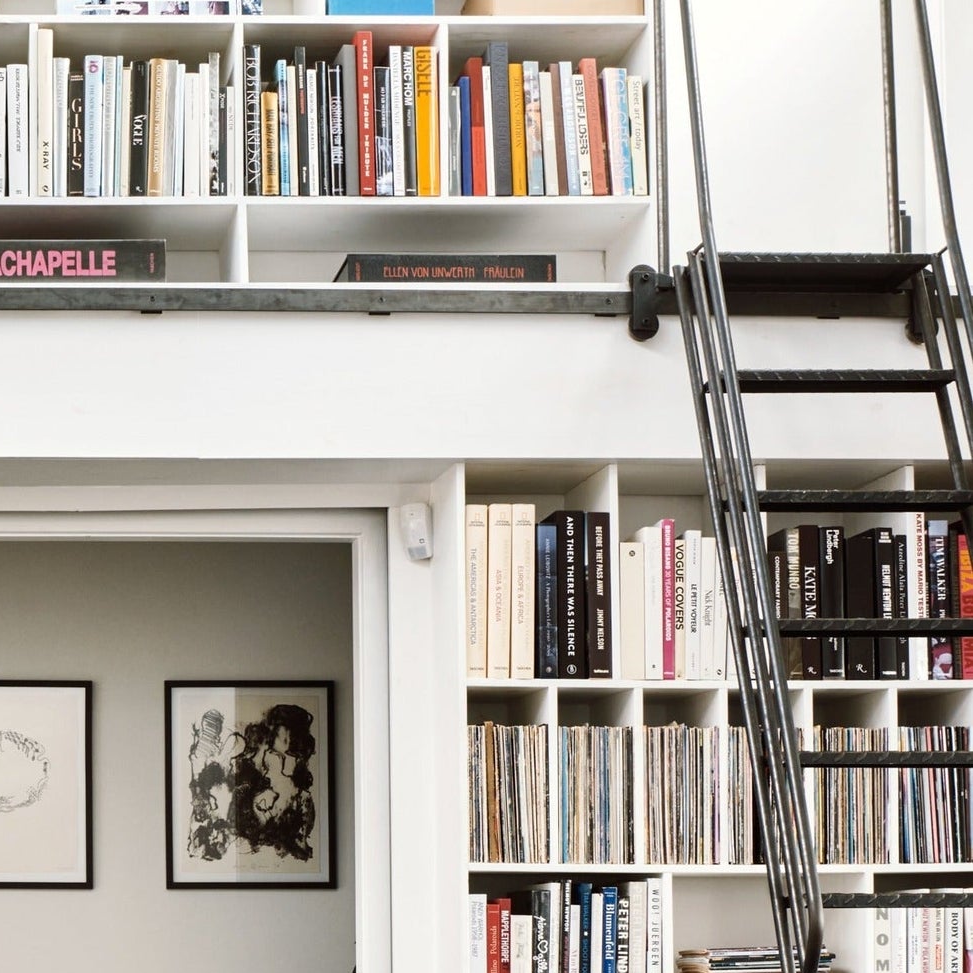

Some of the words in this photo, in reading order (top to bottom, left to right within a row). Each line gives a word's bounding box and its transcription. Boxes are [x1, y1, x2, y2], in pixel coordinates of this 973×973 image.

[403, 51, 412, 80] MARC
[416, 50, 432, 98] GISELE
[404, 82, 413, 106] HOM
[132, 114, 146, 146] VOGUE
[246, 90, 260, 184] RICHARDSON
[634, 128, 642, 150] today
[383, 266, 408, 278] ELLEN
[410, 266, 429, 278] VON
[566, 516, 574, 536] AND
[595, 526, 603, 548] BEFORE
[470, 548, 478, 562] THE
[566, 538, 574, 563] THEN
[788, 533, 800, 553] TOM
[826, 530, 834, 564] Lindbergh
[936, 536, 944, 557] TIM
[596, 564, 604, 579] PASS
[676, 544, 684, 583] VOGUE
[788, 556, 800, 589] MUNRO
[882, 564, 890, 587] HELMUT
[918, 558, 923, 569] BY
[470, 562, 478, 597] AMERICAS
[567, 566, 575, 594] THERE
[596, 579, 604, 596] AWAY
[805, 566, 816, 601] KATE
[936, 558, 946, 601] WALKER
[567, 596, 575, 616] WAS
[596, 608, 604, 626] JIMMY
[676, 586, 684, 630] COVERS
[702, 605, 712, 626] Knight
[470, 604, 478, 646] ANTARCTICA
[568, 618, 576, 656] SILENCE
[605, 904, 614, 960] Blumenfeld
[618, 898, 628, 939] PETER
[501, 910, 510, 962] MAPPLETHORPE
[652, 921, 660, 966] JUERGEN
[951, 940, 958, 953] OF
